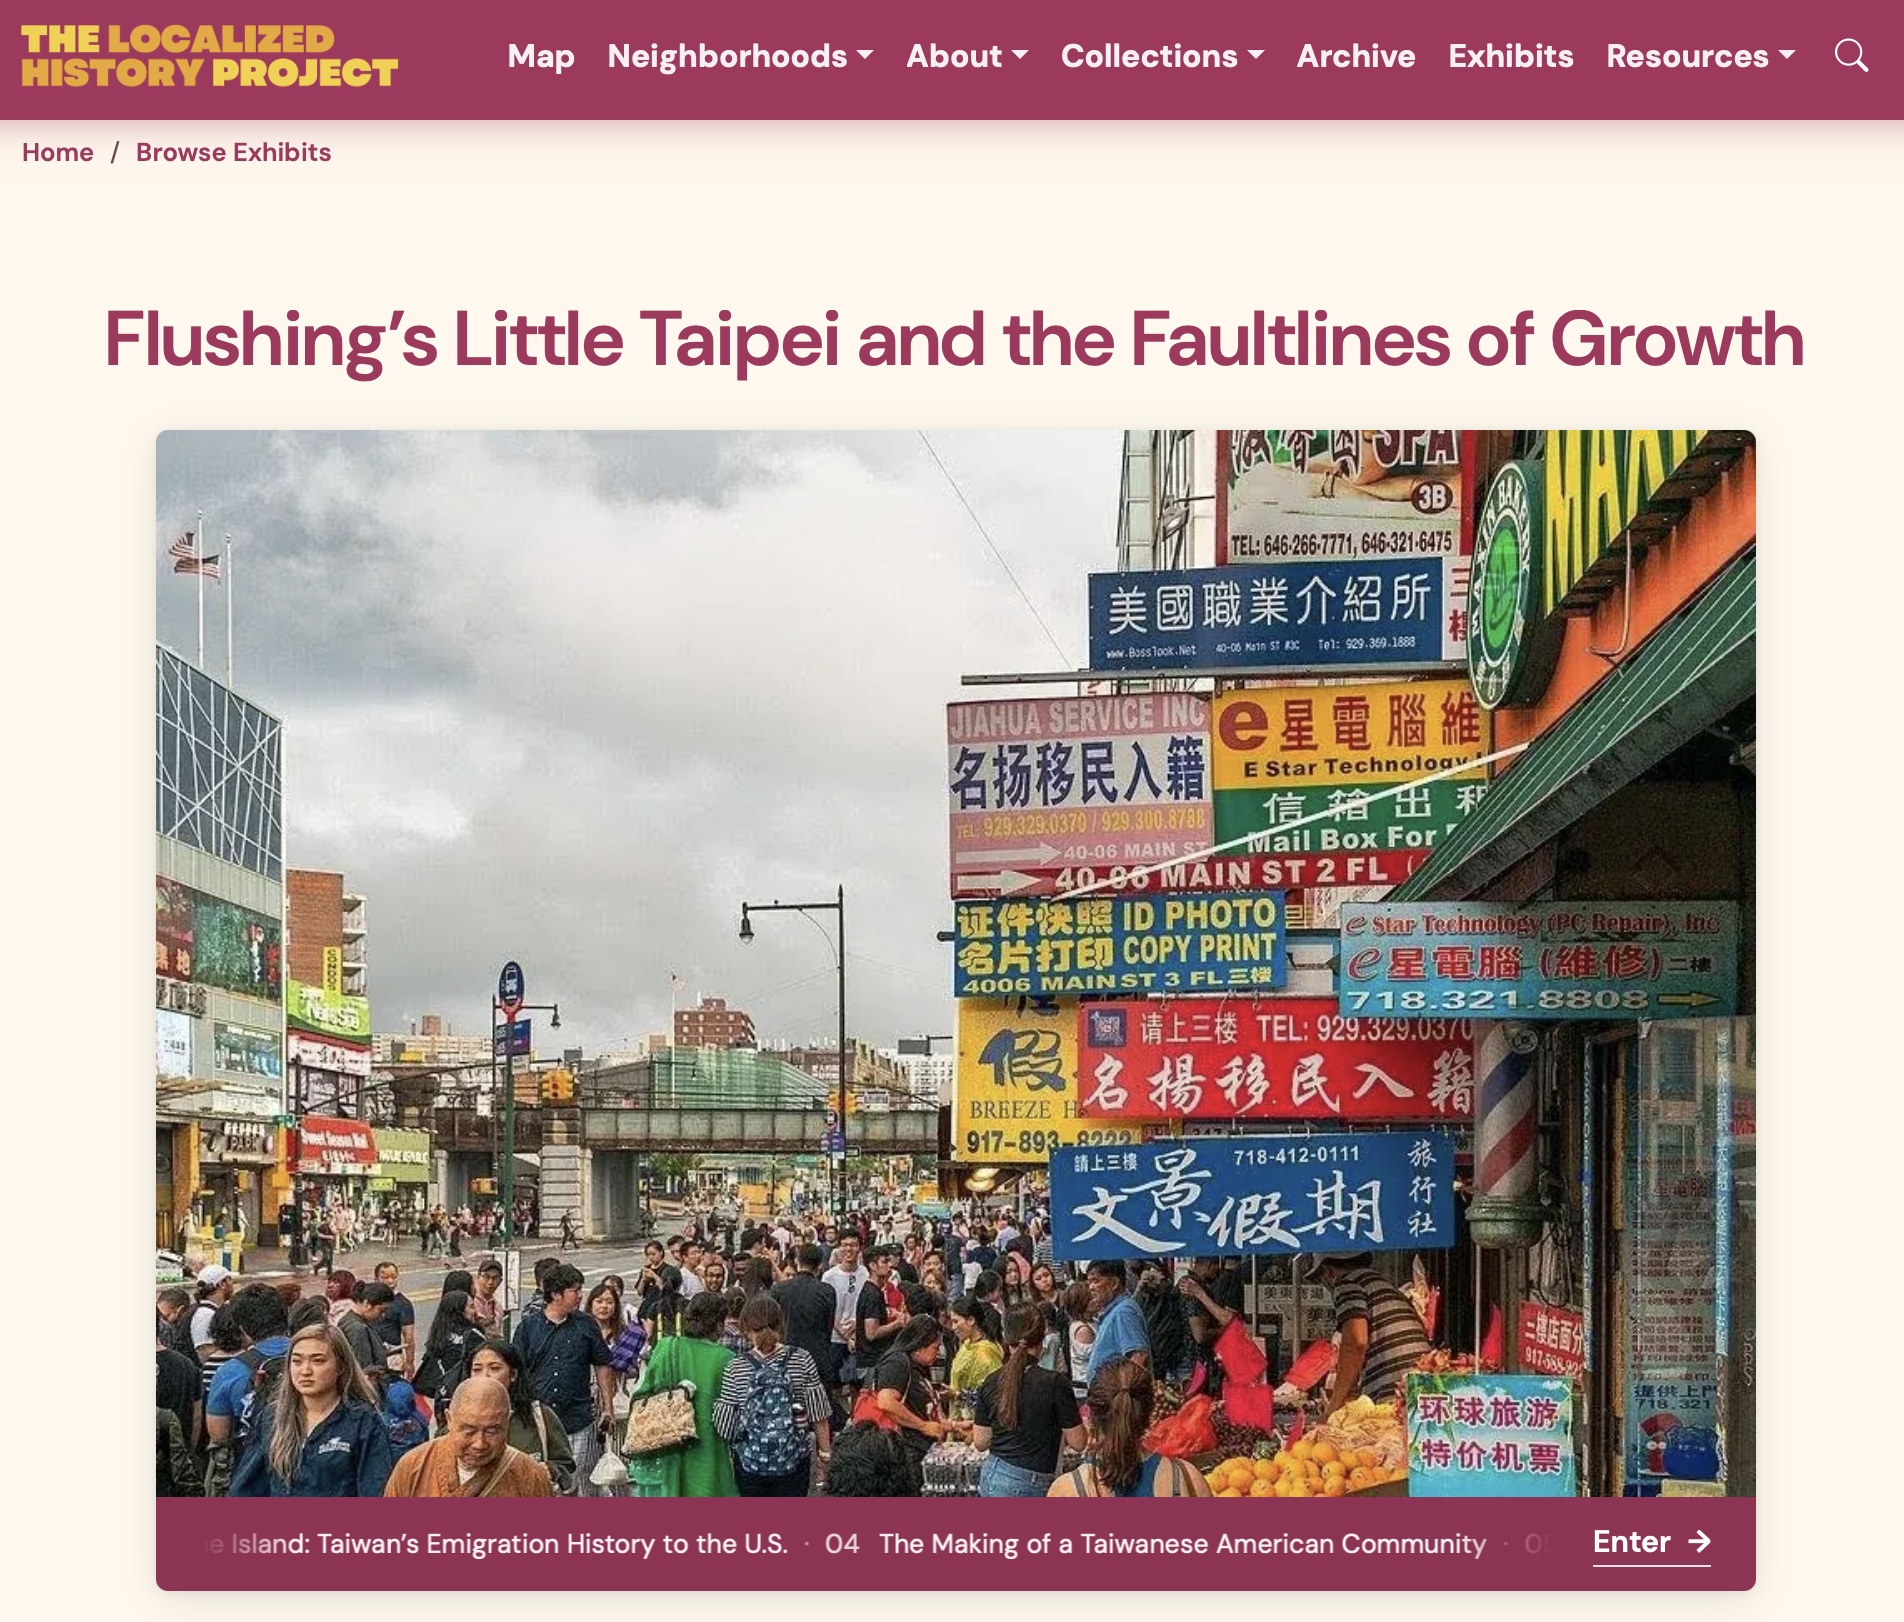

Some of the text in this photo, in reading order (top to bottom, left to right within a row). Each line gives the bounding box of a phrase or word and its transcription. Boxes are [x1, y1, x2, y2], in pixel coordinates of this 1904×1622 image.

[1418, 484, 1447, 509] 3B
[1231, 534, 1260, 556] TEL:
[1108, 572, 1431, 635] 美國職業介紹所
[951, 697, 1205, 739] JIAHUA SERVICE INC
[950, 735, 1205, 810] 名扬移民入籍
[1244, 761, 1258, 778] E
[1266, 760, 1317, 777] Star
[1324, 755, 1468, 775] Technology
[1063, 844, 1117, 860] 40-06
[1125, 842, 1176, 858] MAIN
[1248, 828, 1311, 853] Mail
[1320, 828, 1380, 851] Box
[1387, 826, 1437, 848] For
[1055, 865, 1149, 891] 40-06
[1161, 858, 1250, 888] MAIN
[1262, 858, 1306, 884] ST
[1316, 858, 1336, 882] 2
[1347, 856, 1388, 881] FL
[957, 901, 1114, 938] 证件快照
[1123, 901, 1155, 931] ID
[1165, 898, 1277, 930] PHOTO
[1372, 914, 1417, 935] Star
[1422, 912, 1543, 938] Technology
[957, 937, 1114, 976] 名片打印
[1123, 932, 1277, 964] COPY PRINT
[962, 977, 1031, 993] 4006
[1164, 972, 1180, 986] 3
[1346, 989, 1650, 1011] 718.321.8808
[1140, 1012, 1238, 1045] 请上三楼
[1256, 1014, 1474, 1042] TEL: 929.329.0370
[1082, 1048, 1475, 1115] 名揚移民入籍
[970, 1100, 1082, 1119] BREEZE H
[1233, 1145, 1360, 1167] 718-412-0111
[1071, 1147, 1385, 1253] 文景假期
[1407, 1138, 1437, 1238] 旅行社
[1417, 1394, 1560, 1431] 环球旅游
[1419, 1438, 1563, 1475] 特价机票
